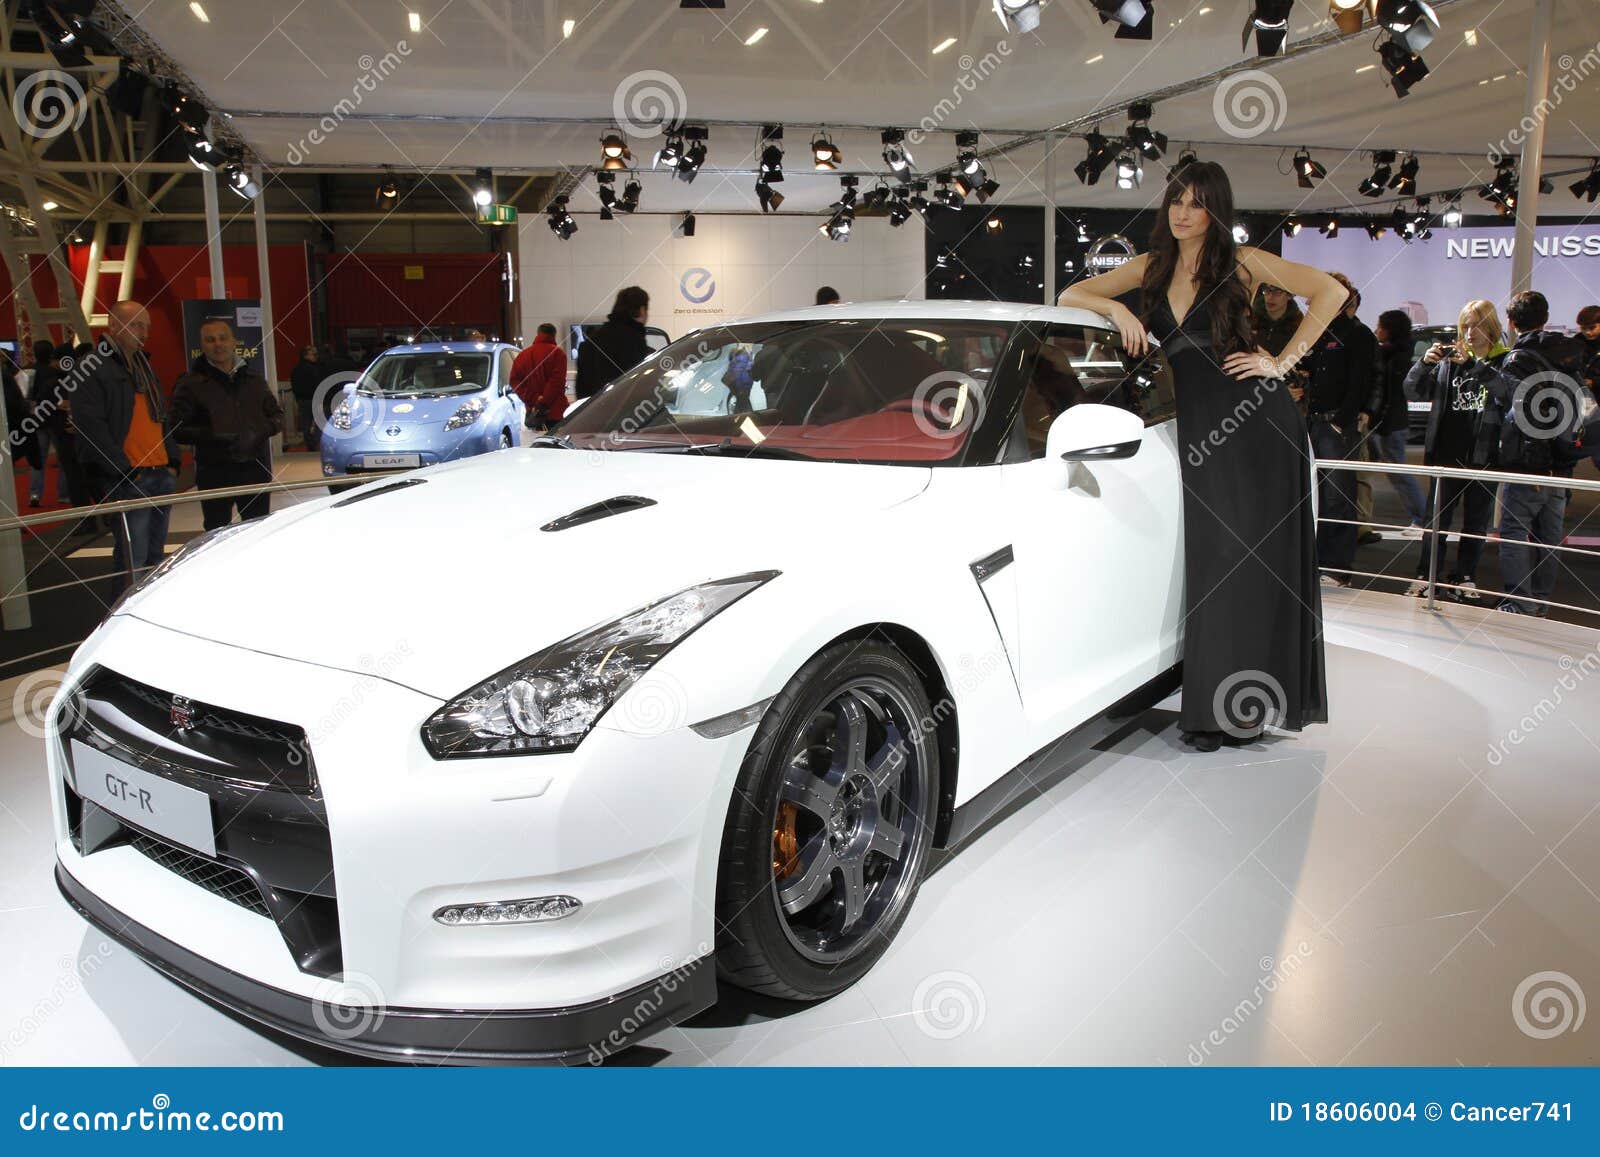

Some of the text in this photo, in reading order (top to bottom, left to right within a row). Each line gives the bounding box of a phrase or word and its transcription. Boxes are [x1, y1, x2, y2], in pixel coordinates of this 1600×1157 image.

[1447, 238, 1516, 258] NEW
[1092, 256, 1132, 266] NISSA
[105, 773, 154, 814] GT-R
